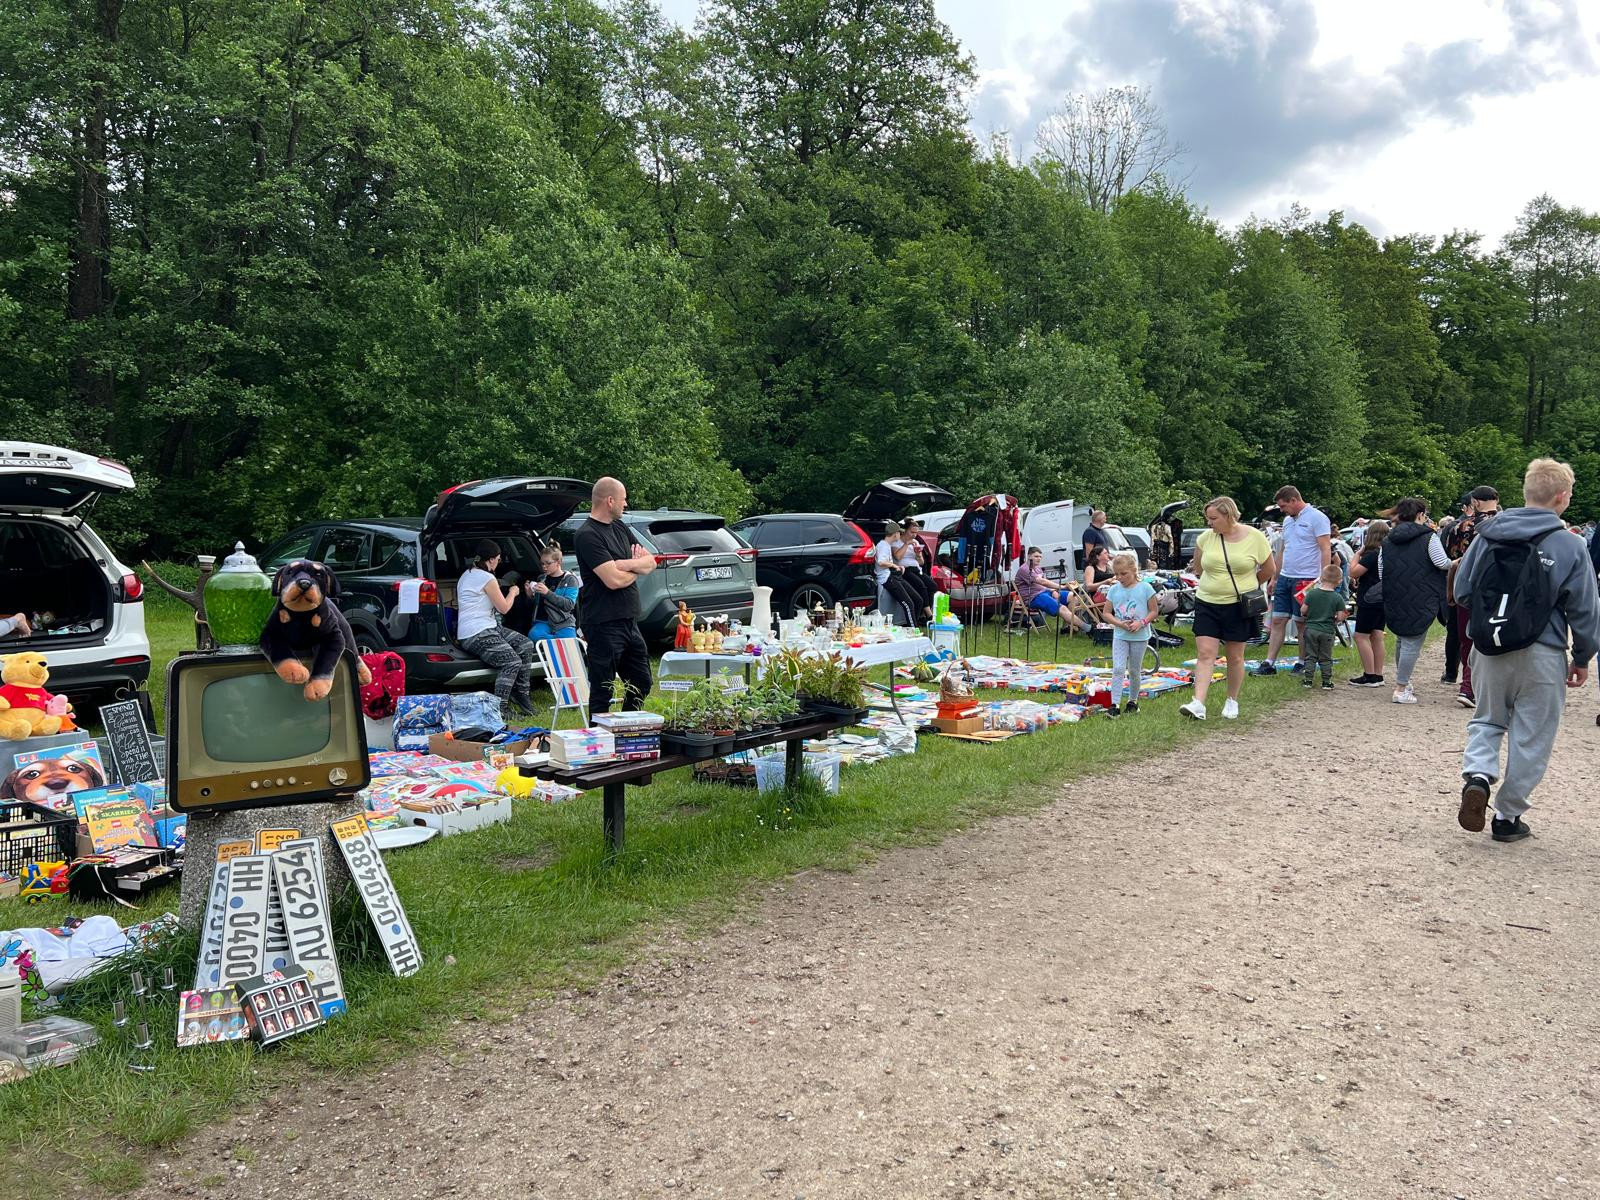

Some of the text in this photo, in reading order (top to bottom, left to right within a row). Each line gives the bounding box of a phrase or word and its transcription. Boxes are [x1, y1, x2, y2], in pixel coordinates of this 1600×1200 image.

[224, 860, 264, 986] HH 0400
[278, 851, 321, 920] 6254
[345, 839, 418, 973] HH 040488
[293, 924, 330, 961] AU
